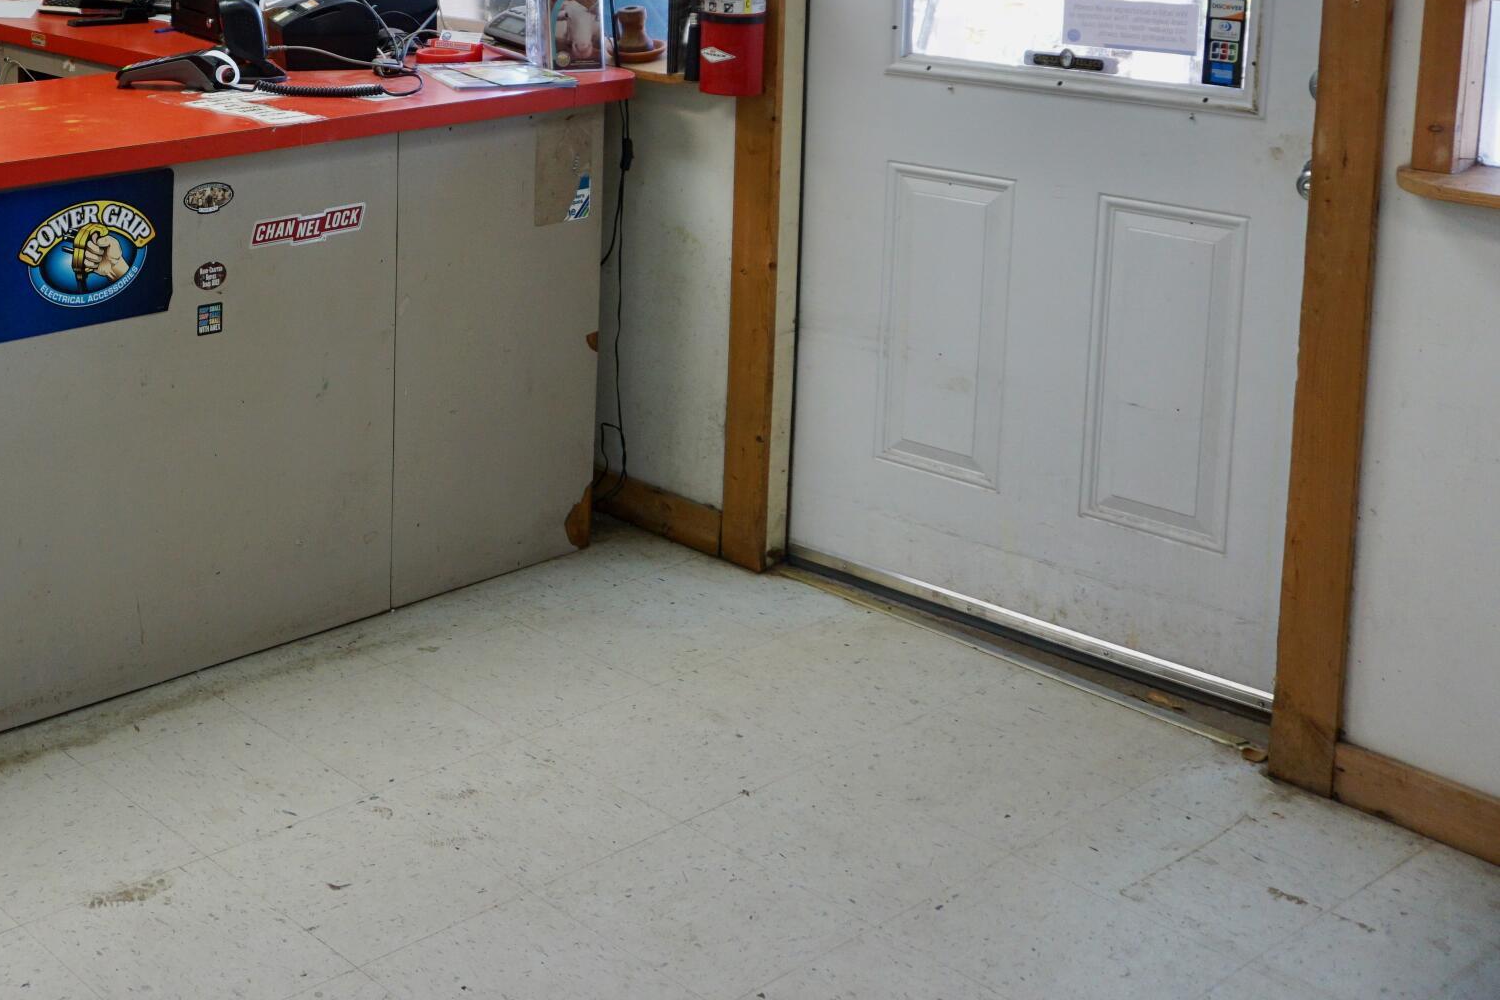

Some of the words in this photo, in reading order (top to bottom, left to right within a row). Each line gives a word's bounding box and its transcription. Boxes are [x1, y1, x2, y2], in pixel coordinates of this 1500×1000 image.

[1212, 2, 1243, 11] DISCOVER
[22, 204, 100, 262] POWER
[102, 203, 151, 241] GRIP
[40, 284, 86, 304] ELECTRICAL
[87, 265, 139, 303] ACCESSORIES
